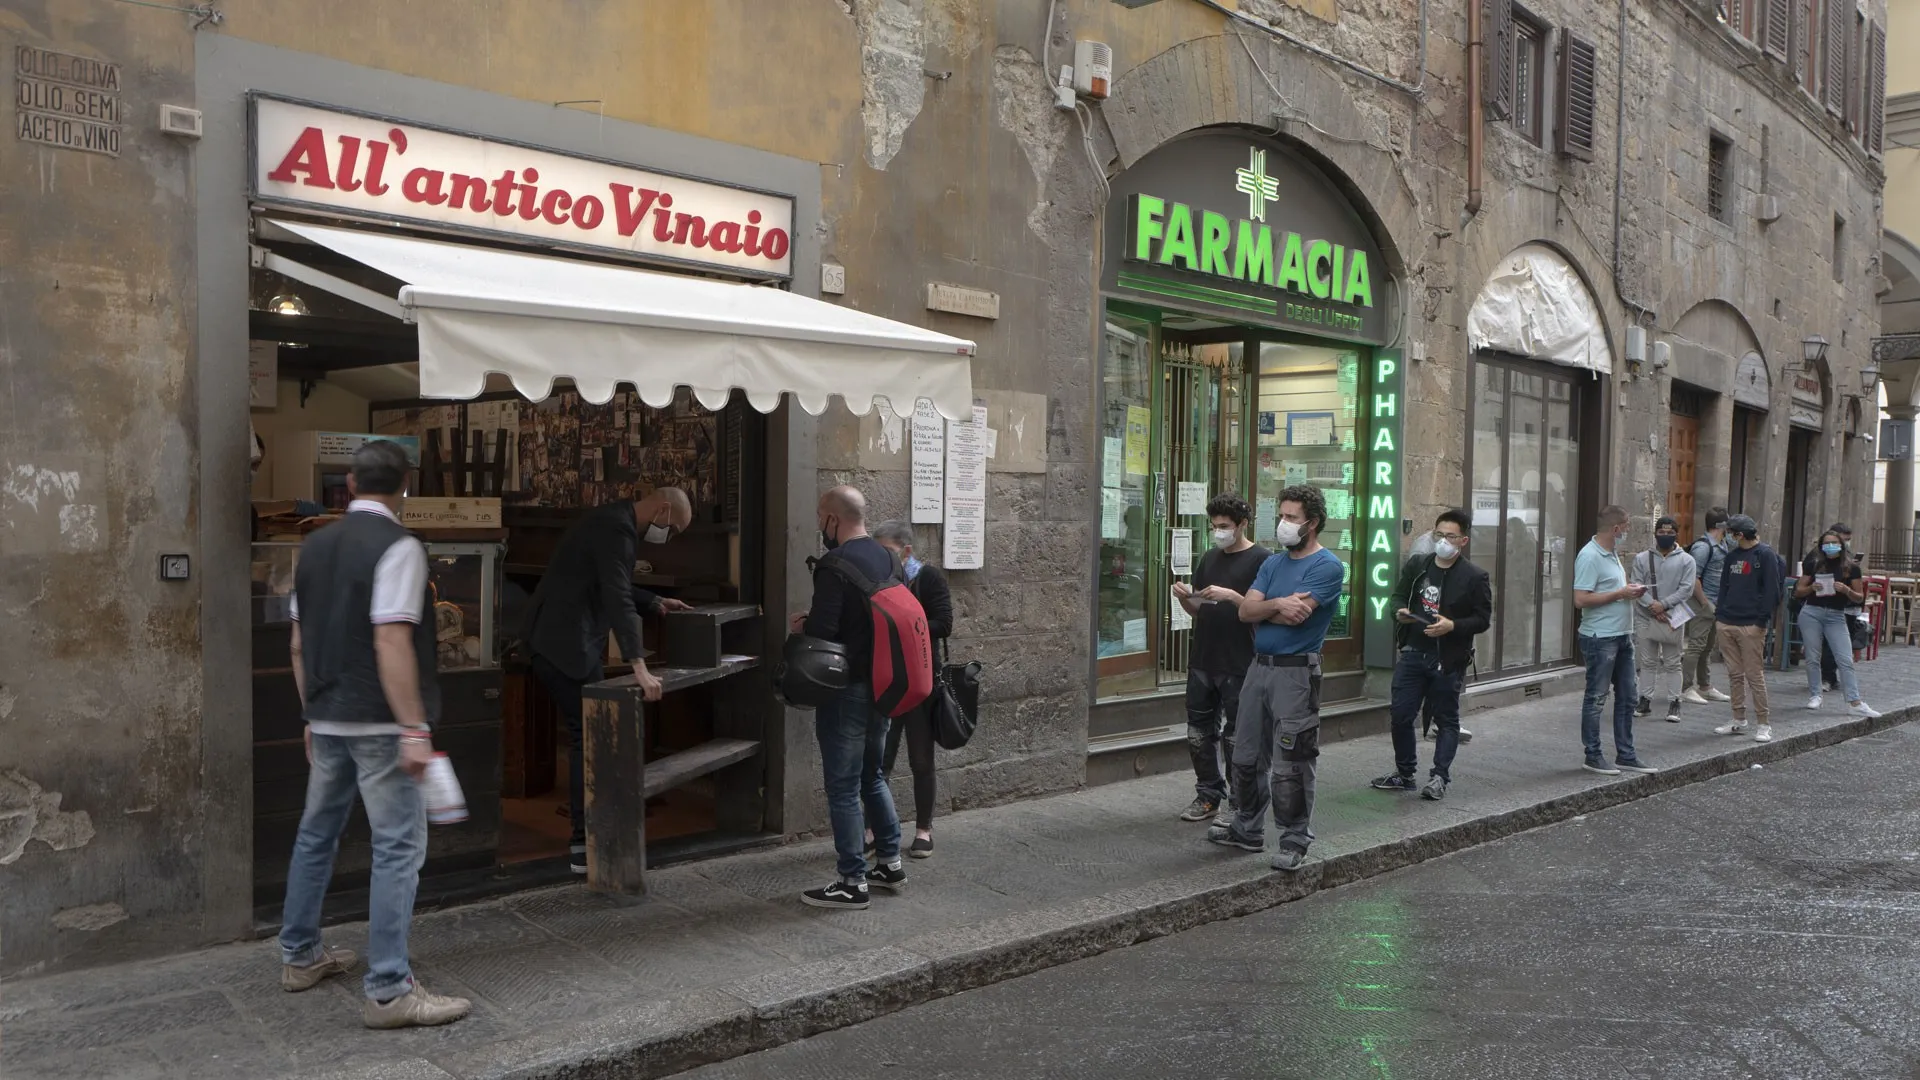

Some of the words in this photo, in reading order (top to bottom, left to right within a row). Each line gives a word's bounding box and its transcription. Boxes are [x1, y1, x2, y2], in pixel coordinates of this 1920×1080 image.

[20, 47, 58, 78] OLIO
[71, 58, 118, 90] OLIVA
[20, 81, 62, 111] OLIO
[75, 91, 119, 121] SEMI
[21, 114, 71, 146] ACETO
[74, 136, 82, 149] DI
[84, 123, 119, 152] VINO
[609, 181, 790, 261] Vinaio
[1135, 192, 1374, 308] FARMACIA
[824, 267, 843, 288] 65
[1286, 302, 1323, 324] DEGLI
[1325, 308, 1364, 332] UFFIZI
[1369, 359, 1396, 620] PHARMACY
